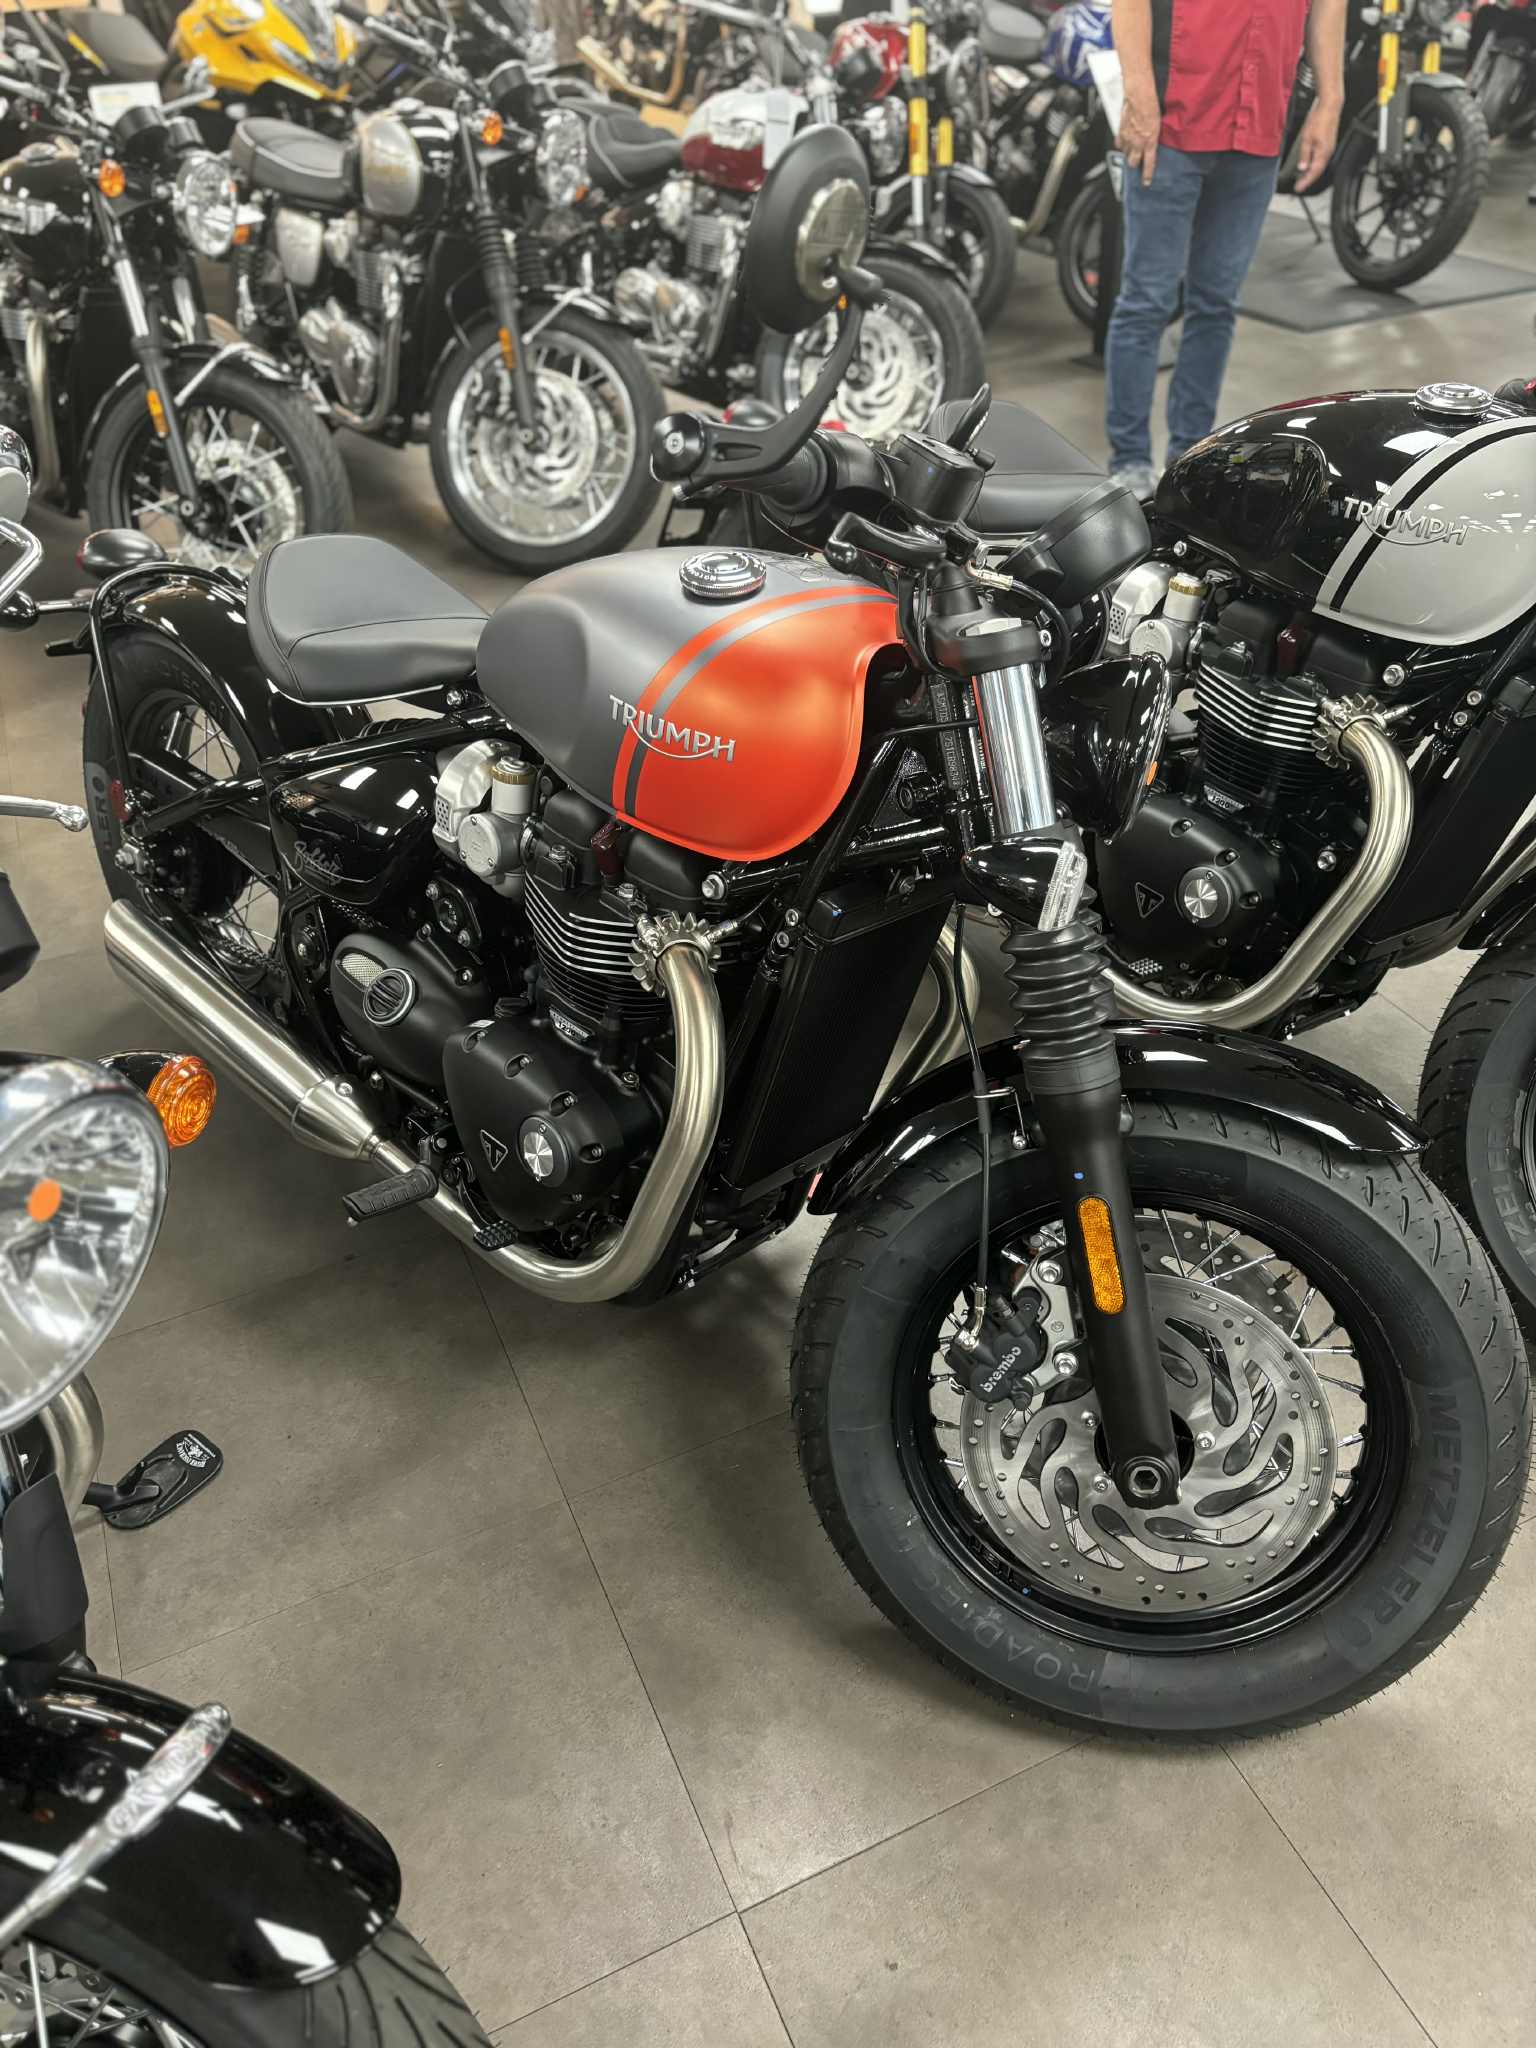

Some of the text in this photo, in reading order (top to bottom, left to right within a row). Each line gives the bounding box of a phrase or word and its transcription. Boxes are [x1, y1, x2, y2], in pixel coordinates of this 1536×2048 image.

[1343, 496, 1470, 546] TRIUMPH
[609, 694, 737, 762] TRIUMPH
[979, 1345, 1022, 1393] brembo
[1374, 1392, 1464, 1627] METZELER
